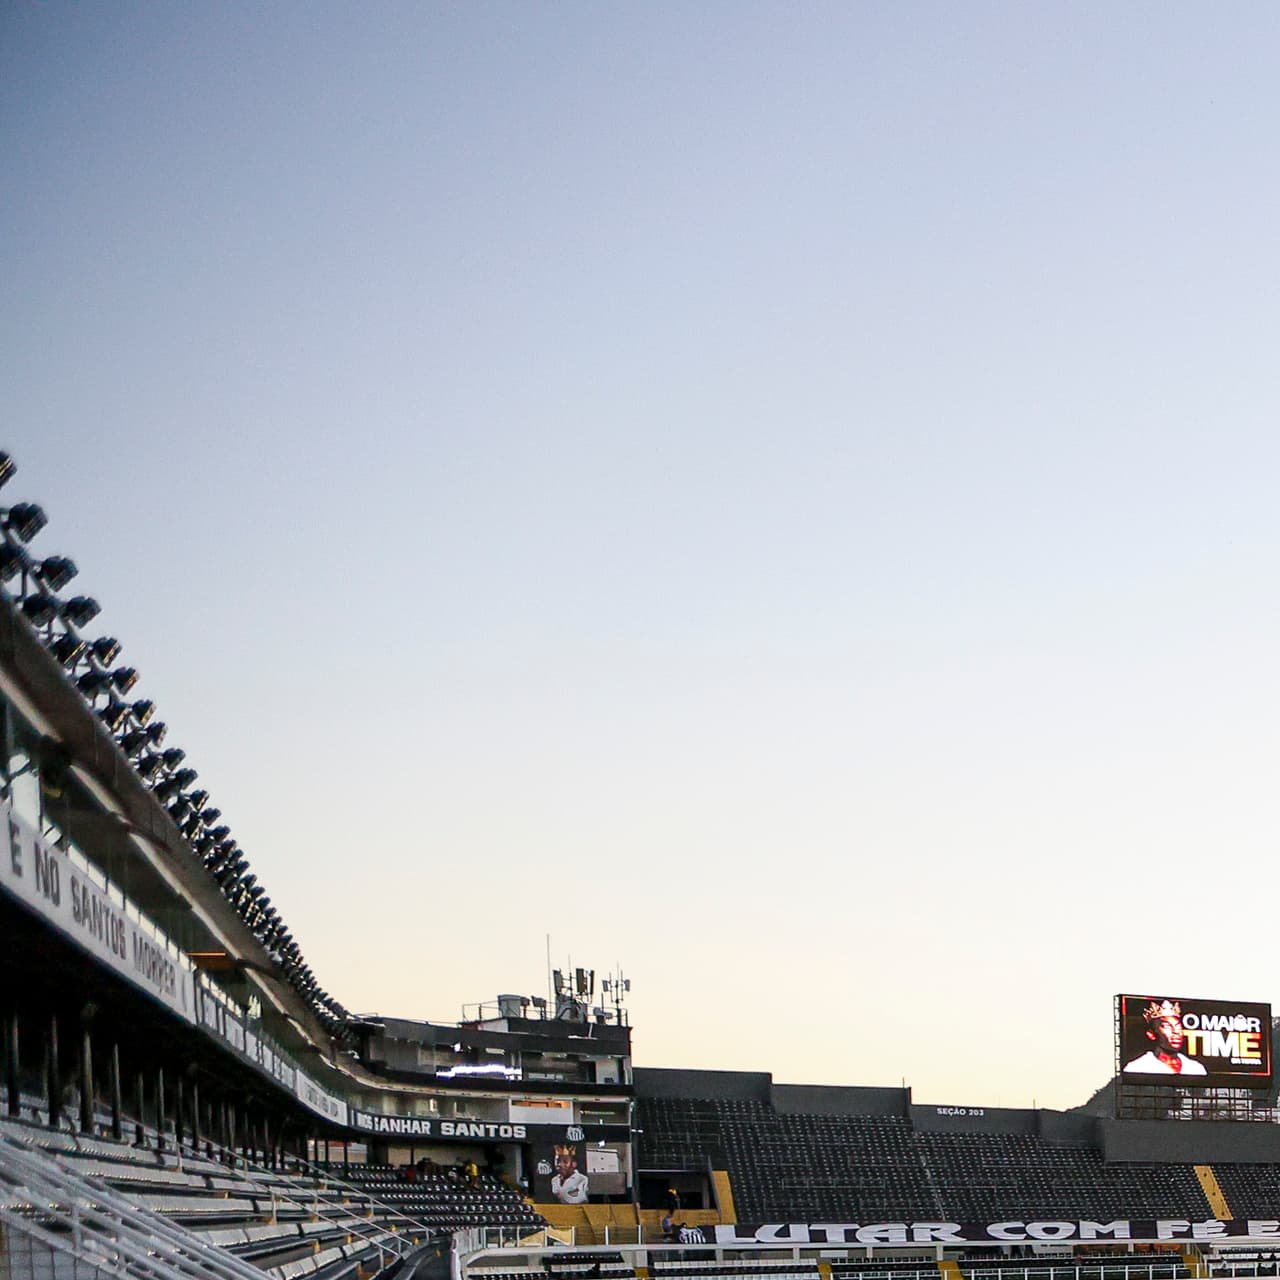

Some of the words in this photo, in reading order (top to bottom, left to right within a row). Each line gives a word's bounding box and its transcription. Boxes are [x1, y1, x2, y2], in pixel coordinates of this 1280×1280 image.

[34, 841, 60, 907] NO
[71, 874, 126, 960] SANTOS
[1182, 1013, 1200, 1030] O
[1183, 1030, 1262, 1058] TIME
[440, 1121, 527, 1139] SANTOS
[715, 1222, 967, 1243] LUTAR
[986, 1220, 1131, 1240] COM
[1156, 1218, 1230, 1239] FÉ
